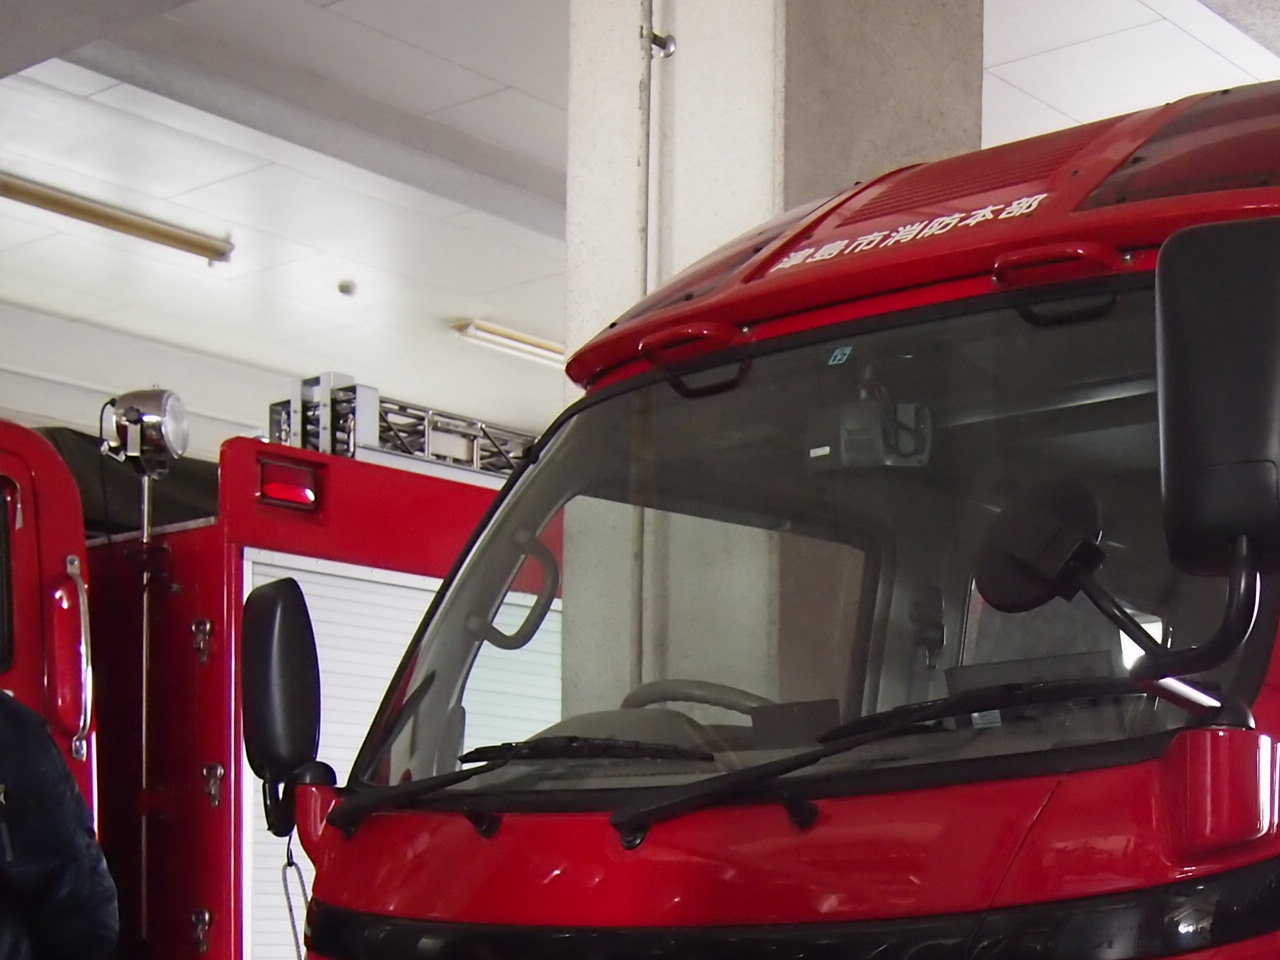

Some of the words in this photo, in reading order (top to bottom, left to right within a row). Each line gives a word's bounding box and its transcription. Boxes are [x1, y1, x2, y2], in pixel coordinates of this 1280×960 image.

[769, 193, 1050, 272] 津島市消防本部
